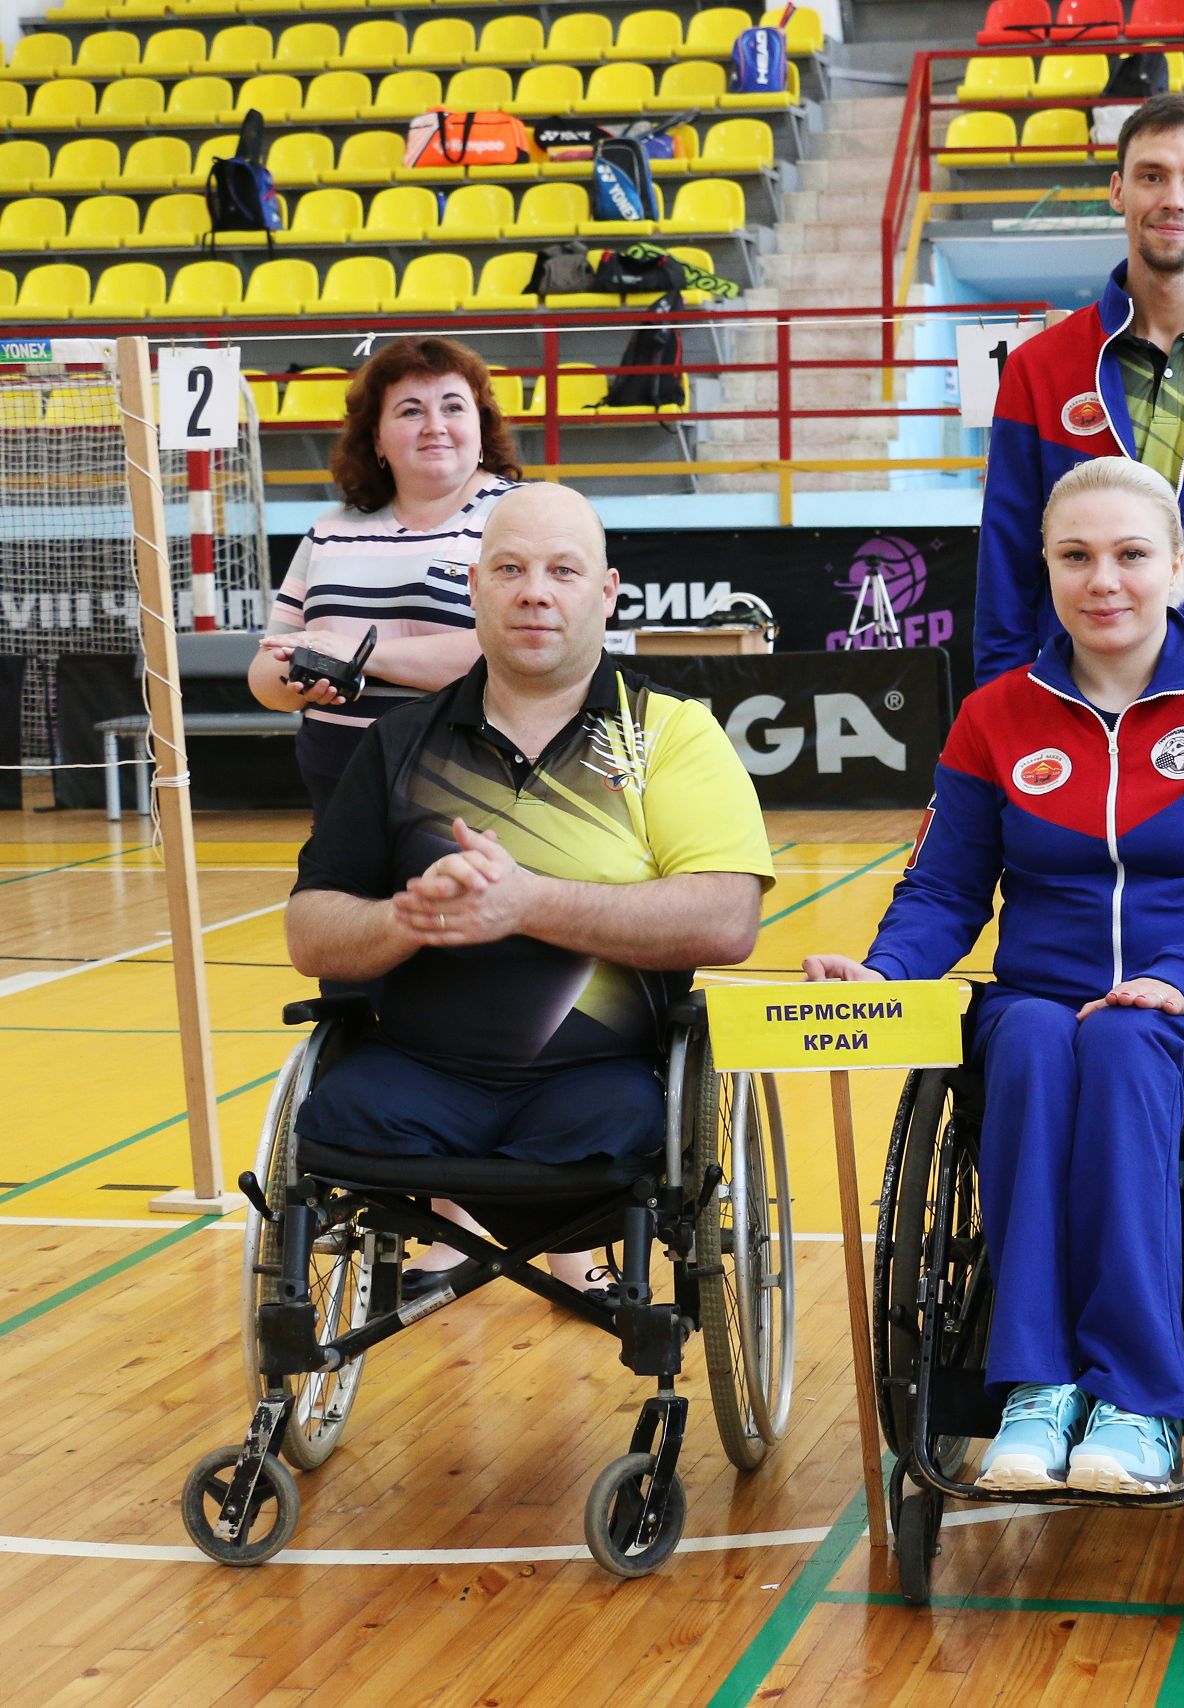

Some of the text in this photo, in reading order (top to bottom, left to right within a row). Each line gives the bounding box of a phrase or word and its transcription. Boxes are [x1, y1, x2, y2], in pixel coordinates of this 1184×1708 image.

[755, 29, 769, 85] HEAD
[608, 182, 641, 221] YONEX
[0, 342, 48, 359] YONEX
[988, 340, 1008, 386] 1
[186, 365, 213, 438] 2
[702, 692, 907, 776] GA
[766, 998, 903, 1022] ПЕРМСКИЙ
[803, 1028, 869, 1051] КРАЙ
